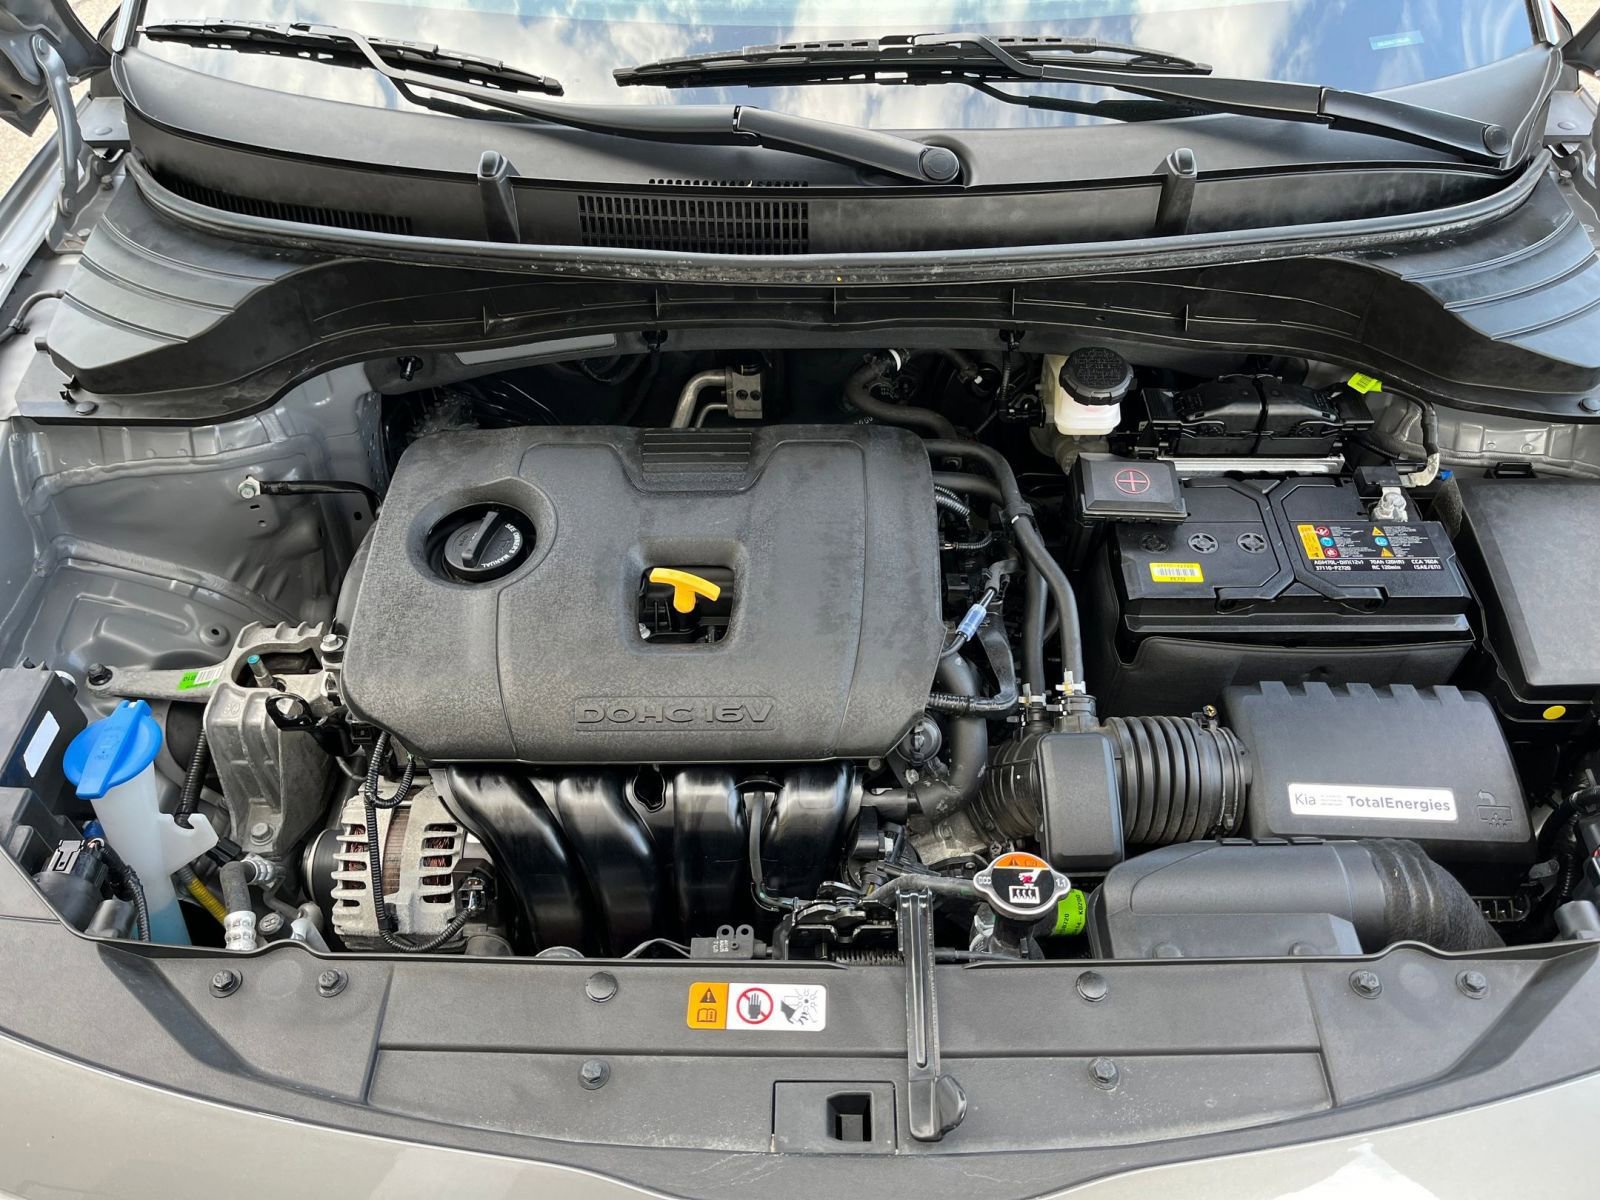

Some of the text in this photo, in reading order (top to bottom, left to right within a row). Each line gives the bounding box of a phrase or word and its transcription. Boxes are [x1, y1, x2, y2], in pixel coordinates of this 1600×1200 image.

[481, 553, 511, 568] MANUAL
[575, 703, 774, 723] DOHC 16V
[1295, 793, 1317, 806] Kia
[1346, 795, 1451, 813] TotalEnergies
